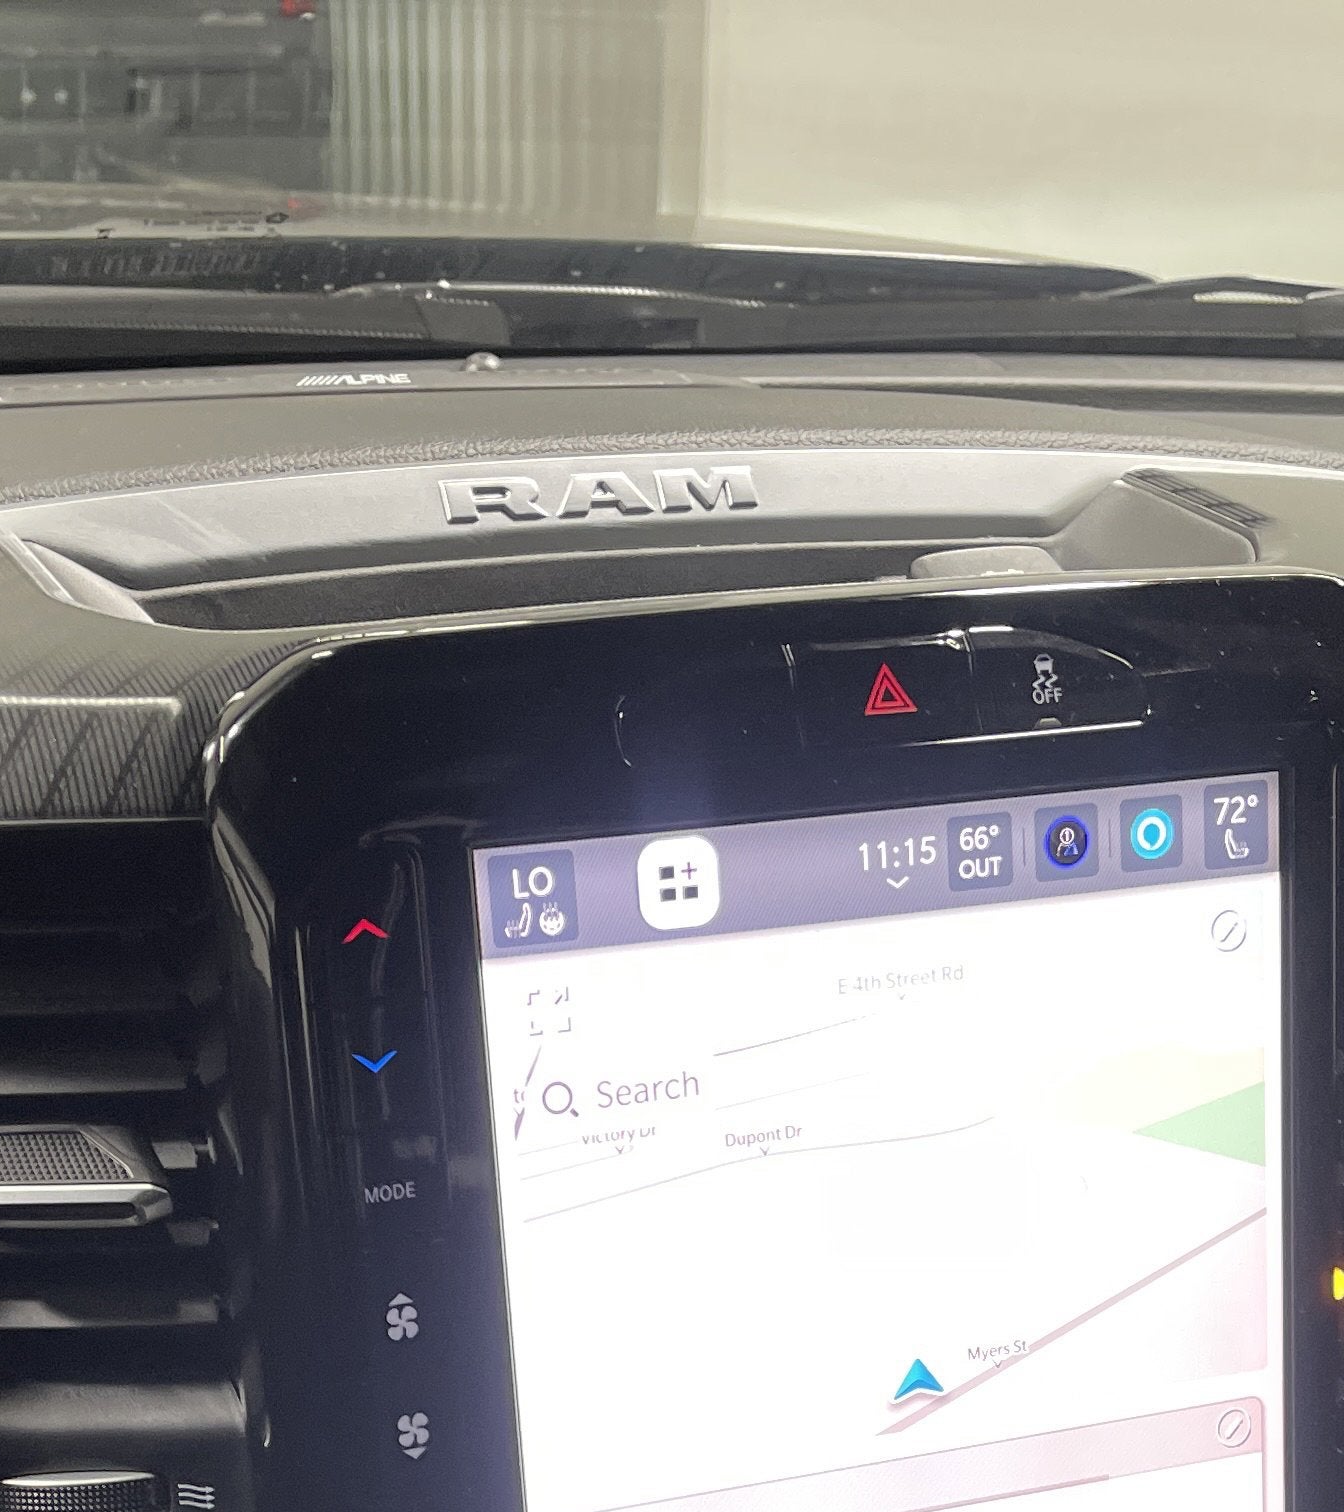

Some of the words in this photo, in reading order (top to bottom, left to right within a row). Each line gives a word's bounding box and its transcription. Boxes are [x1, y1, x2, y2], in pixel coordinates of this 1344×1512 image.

[334, 373, 412, 386] ALPINE
[437, 464, 759, 525] RAM
[1032, 686, 1063, 705] OFF
[1213, 794, 1259, 825] 72°
[959, 824, 1000, 851] 66°
[859, 836, 937, 870] 11:15
[958, 855, 1003, 879] OUT
[512, 866, 554, 899] LO
[838, 978, 848, 994] E
[886, 968, 937, 988] Street
[942, 965, 964, 981] Rd
[596, 1071, 700, 1108] Search
[725, 1128, 781, 1147] Dupont
[785, 1125, 802, 1139] Dr
[364, 1181, 416, 1204] MODE
[968, 1345, 1010, 1361] Myers
[1013, 1339, 1027, 1353] St
